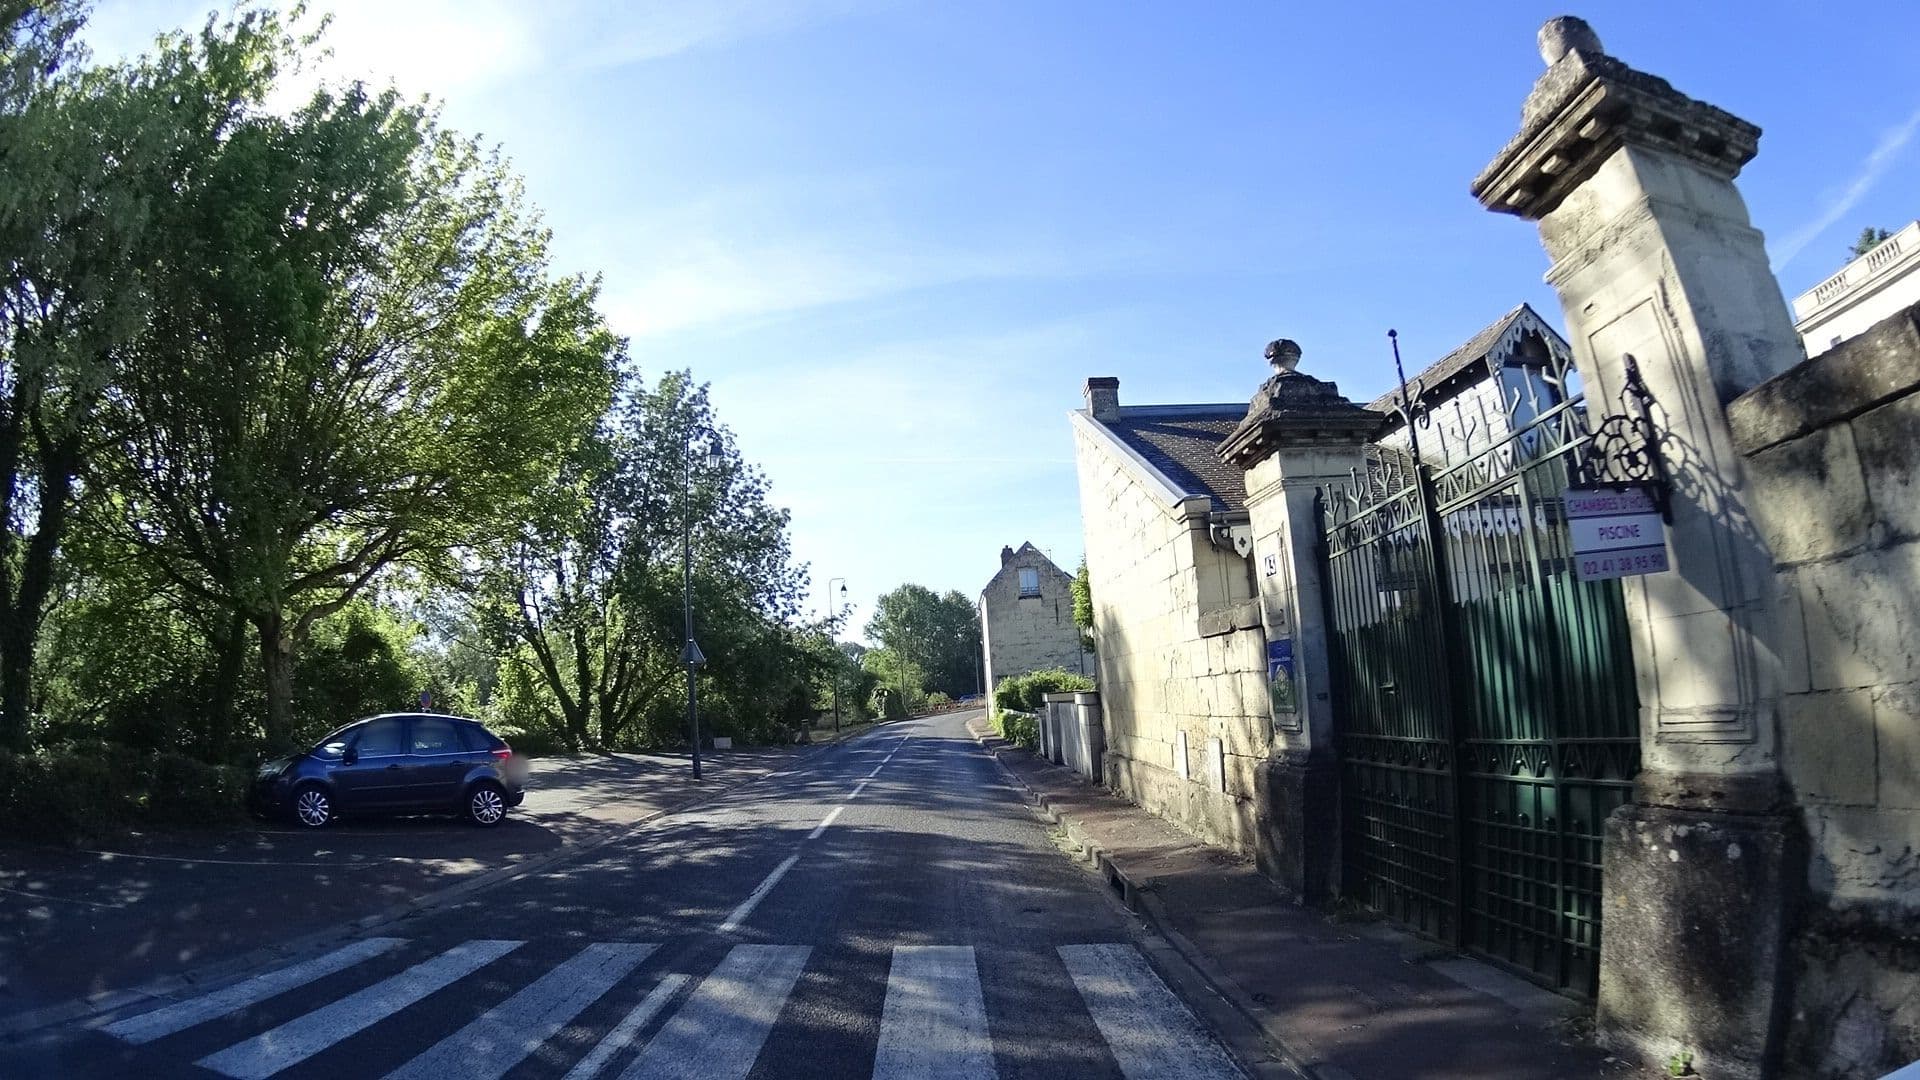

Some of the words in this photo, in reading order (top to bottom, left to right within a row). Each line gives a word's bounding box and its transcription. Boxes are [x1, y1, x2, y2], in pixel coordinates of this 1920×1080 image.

[1568, 497, 1618, 513] CHAMBRES
[1599, 524, 1641, 541] PISCINE
[1583, 561, 1599, 575] 02
[1602, 559, 1615, 572] 41
[1635, 555, 1648, 569] 95
